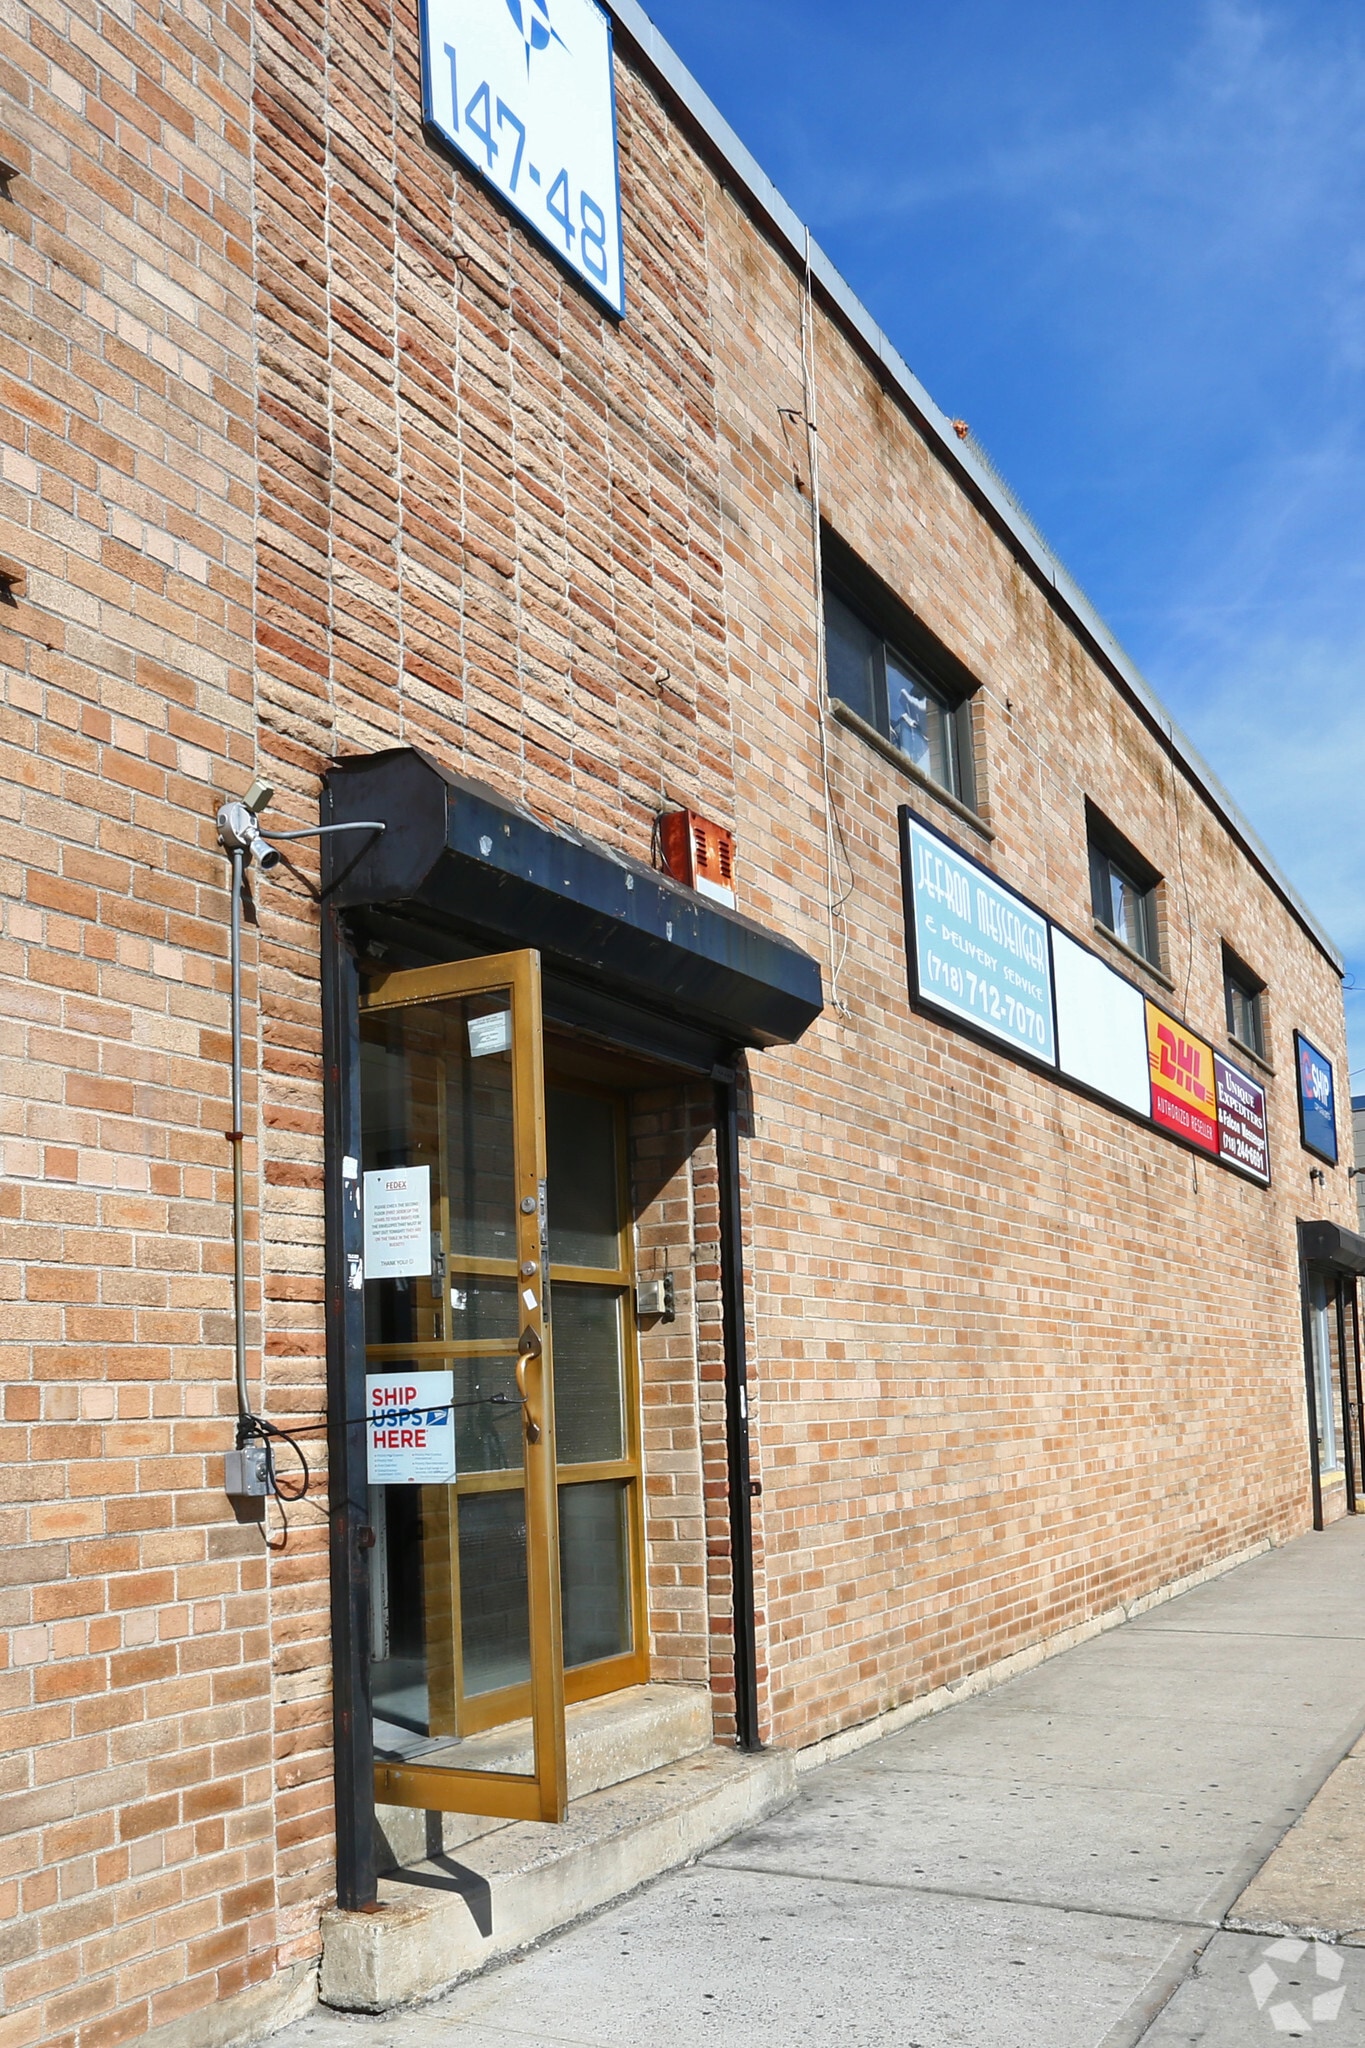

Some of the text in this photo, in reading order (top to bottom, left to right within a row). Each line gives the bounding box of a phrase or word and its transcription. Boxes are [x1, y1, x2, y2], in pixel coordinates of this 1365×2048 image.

[443, 41, 608, 286] 147-48
[976, 887, 1046, 975] MESSENGER
[942, 923, 998, 973] DELIVERY
[1003, 965, 1044, 1002] SERVICE
[927, 949, 1046, 1045] (718) 712-7070
[1157, 1022, 1206, 1102] DHL
[1217, 1081, 1263, 1130] EXPEDITERS
[1224, 1070, 1255, 1108] UNIQUE
[1157, 1095, 1213, 1141] AUTHORIZED RESELLER
[385, 1180, 407, 1190] FEDEX
[372, 1386, 417, 1407] SHIP
[372, 1408, 423, 1428] USPS
[373, 1429, 427, 1449] HERE
